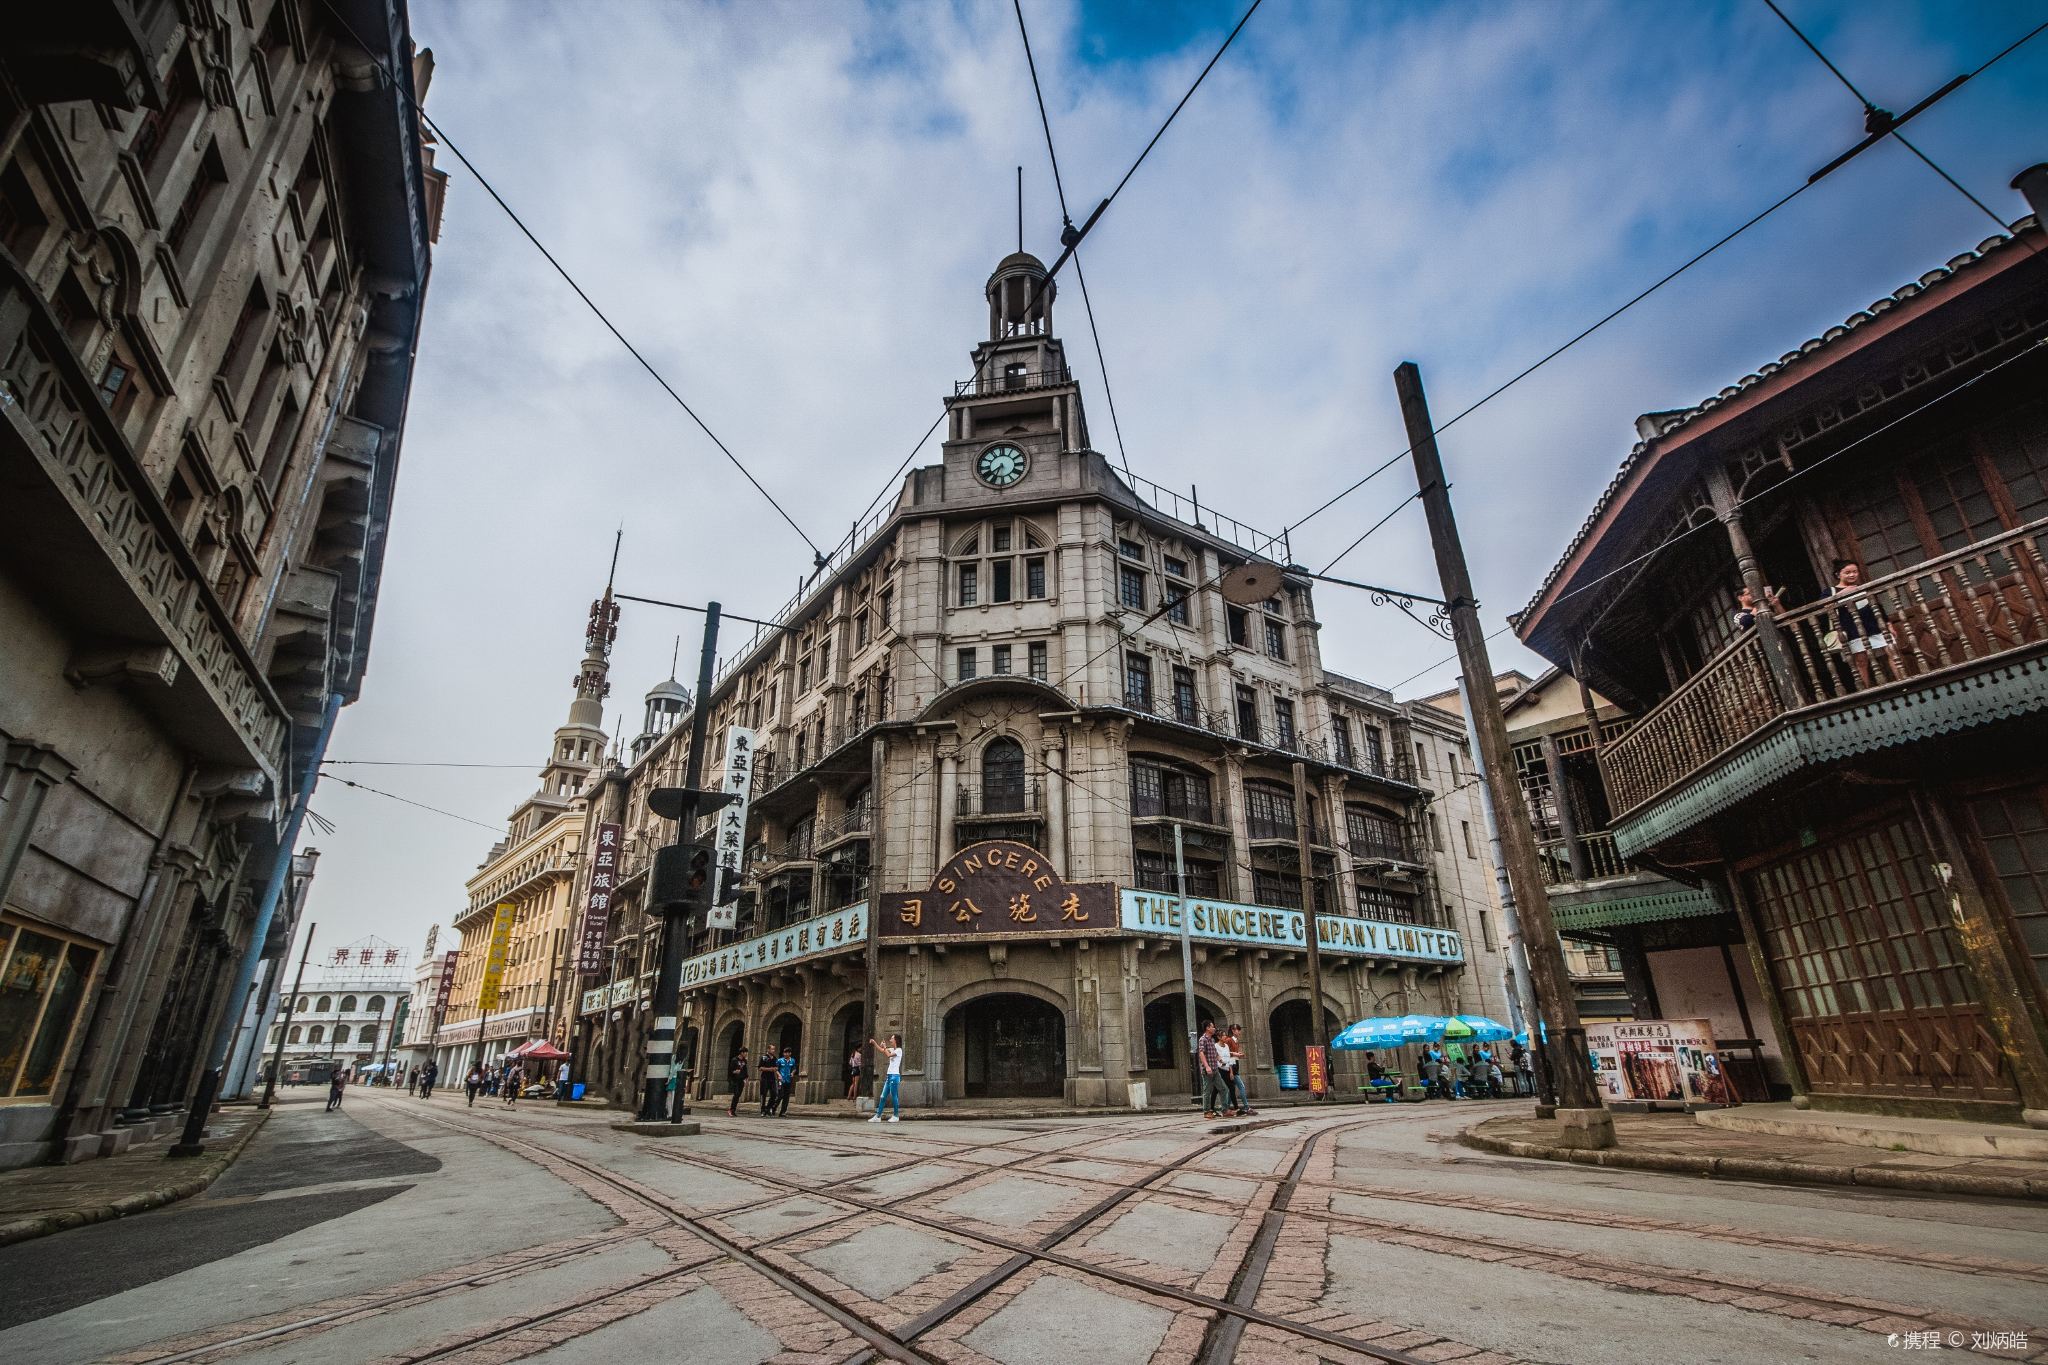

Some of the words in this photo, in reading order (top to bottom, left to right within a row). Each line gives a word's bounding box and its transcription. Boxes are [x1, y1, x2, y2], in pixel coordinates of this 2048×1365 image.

[590, 831, 616, 909] 東亞旅館
[938, 848, 1053, 894] SINCERE
[1135, 896, 1181, 927] THE
[1193, 904, 1287, 939] SINCERE
[1291, 915, 1377, 949] CMPANY
[1385, 927, 1458, 956] LIMITED
[1308, 1048, 1322, 1091] 小卖部
